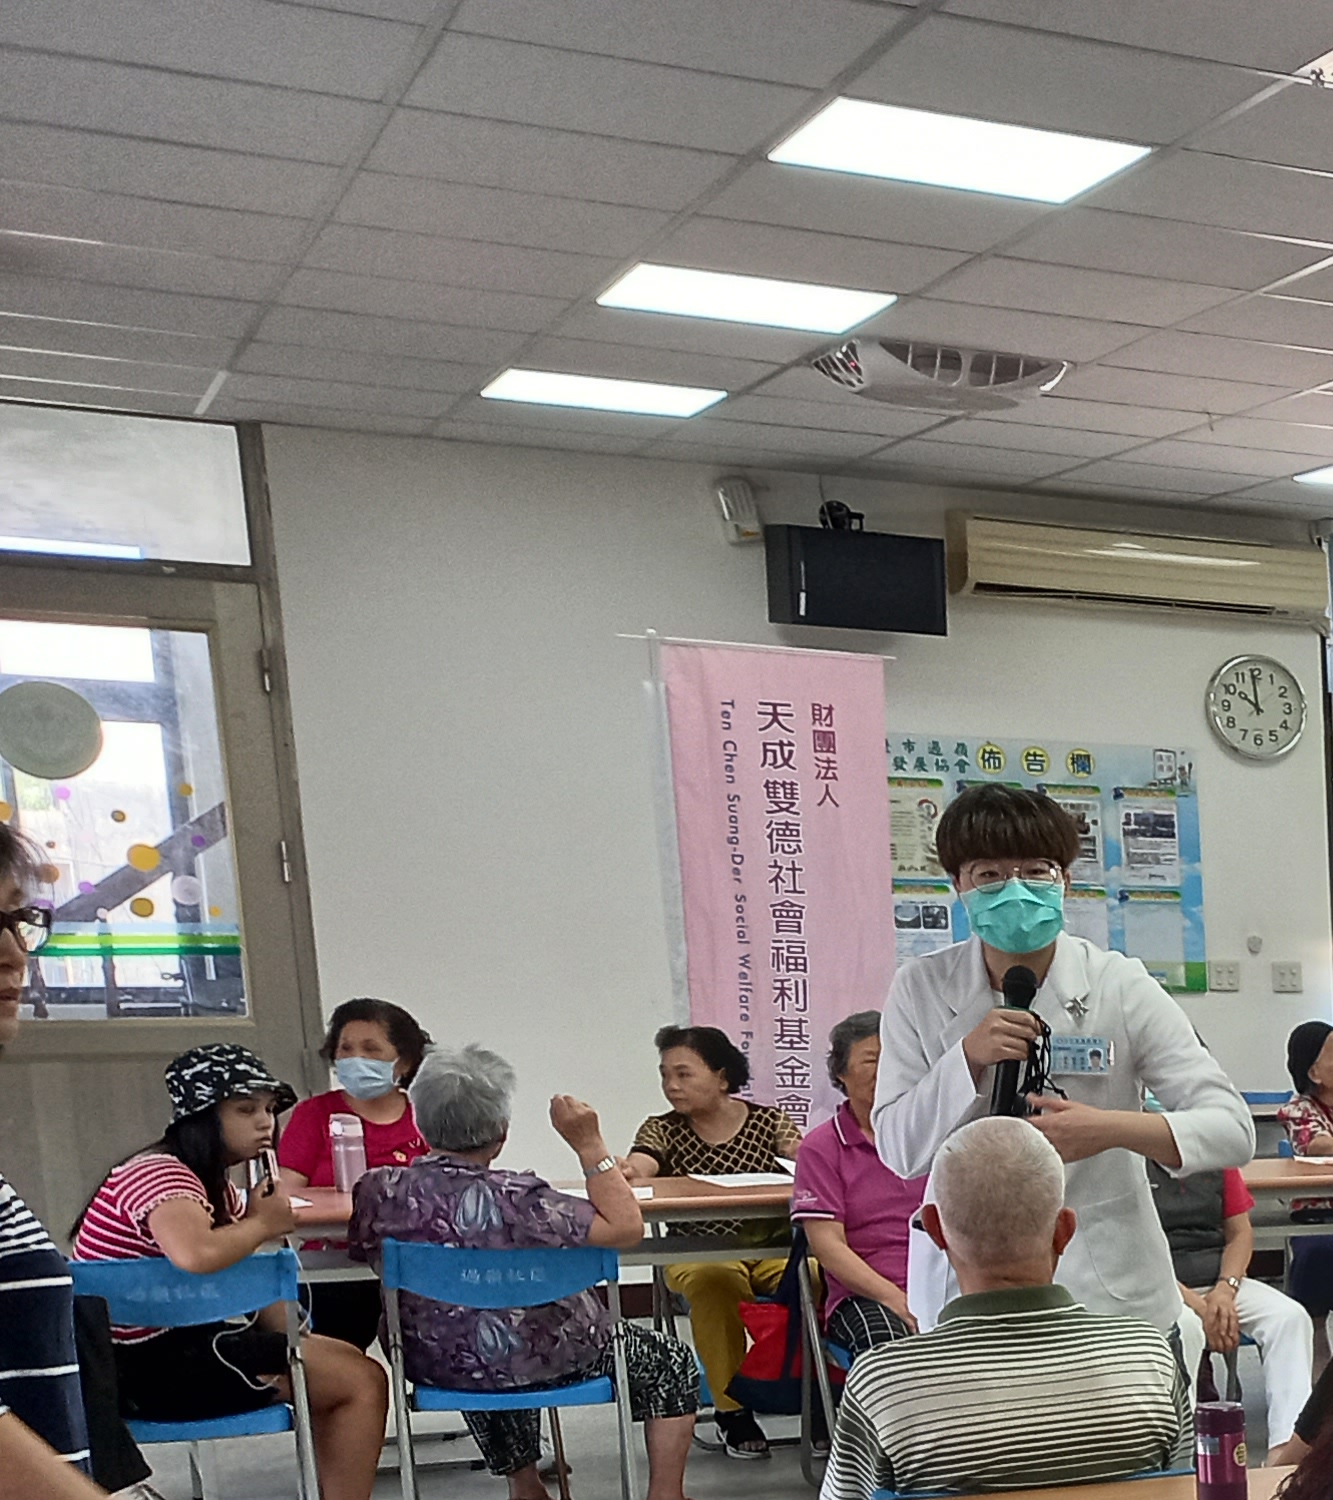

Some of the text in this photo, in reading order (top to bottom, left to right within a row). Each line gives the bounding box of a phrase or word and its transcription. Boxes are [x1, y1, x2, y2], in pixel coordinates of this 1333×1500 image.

[1235, 672, 1246, 684] 11
[1268, 673, 1274, 685] 1
[1221, 683, 1237, 696] 10
[1278, 686, 1288, 699] 2
[1221, 699, 1231, 712] 9
[1283, 702, 1293, 715] 3
[1226, 716, 1236, 729] 8
[1279, 719, 1290, 731] 4
[1239, 728, 1249, 741] 7
[1253, 733, 1263, 746] 6
[1268, 729, 1278, 742] 5
[810, 702, 839, 808] 財團法人
[980, 748, 1092, 775] 佈告欄
[722, 740, 738, 784] Chen
[727, 793, 745, 884] Suang-Der
[734, 894, 750, 945] Social
[756, 700, 812, 1128] 天成雙德社會福利基金會
[738, 953, 754, 1023] Welfare
